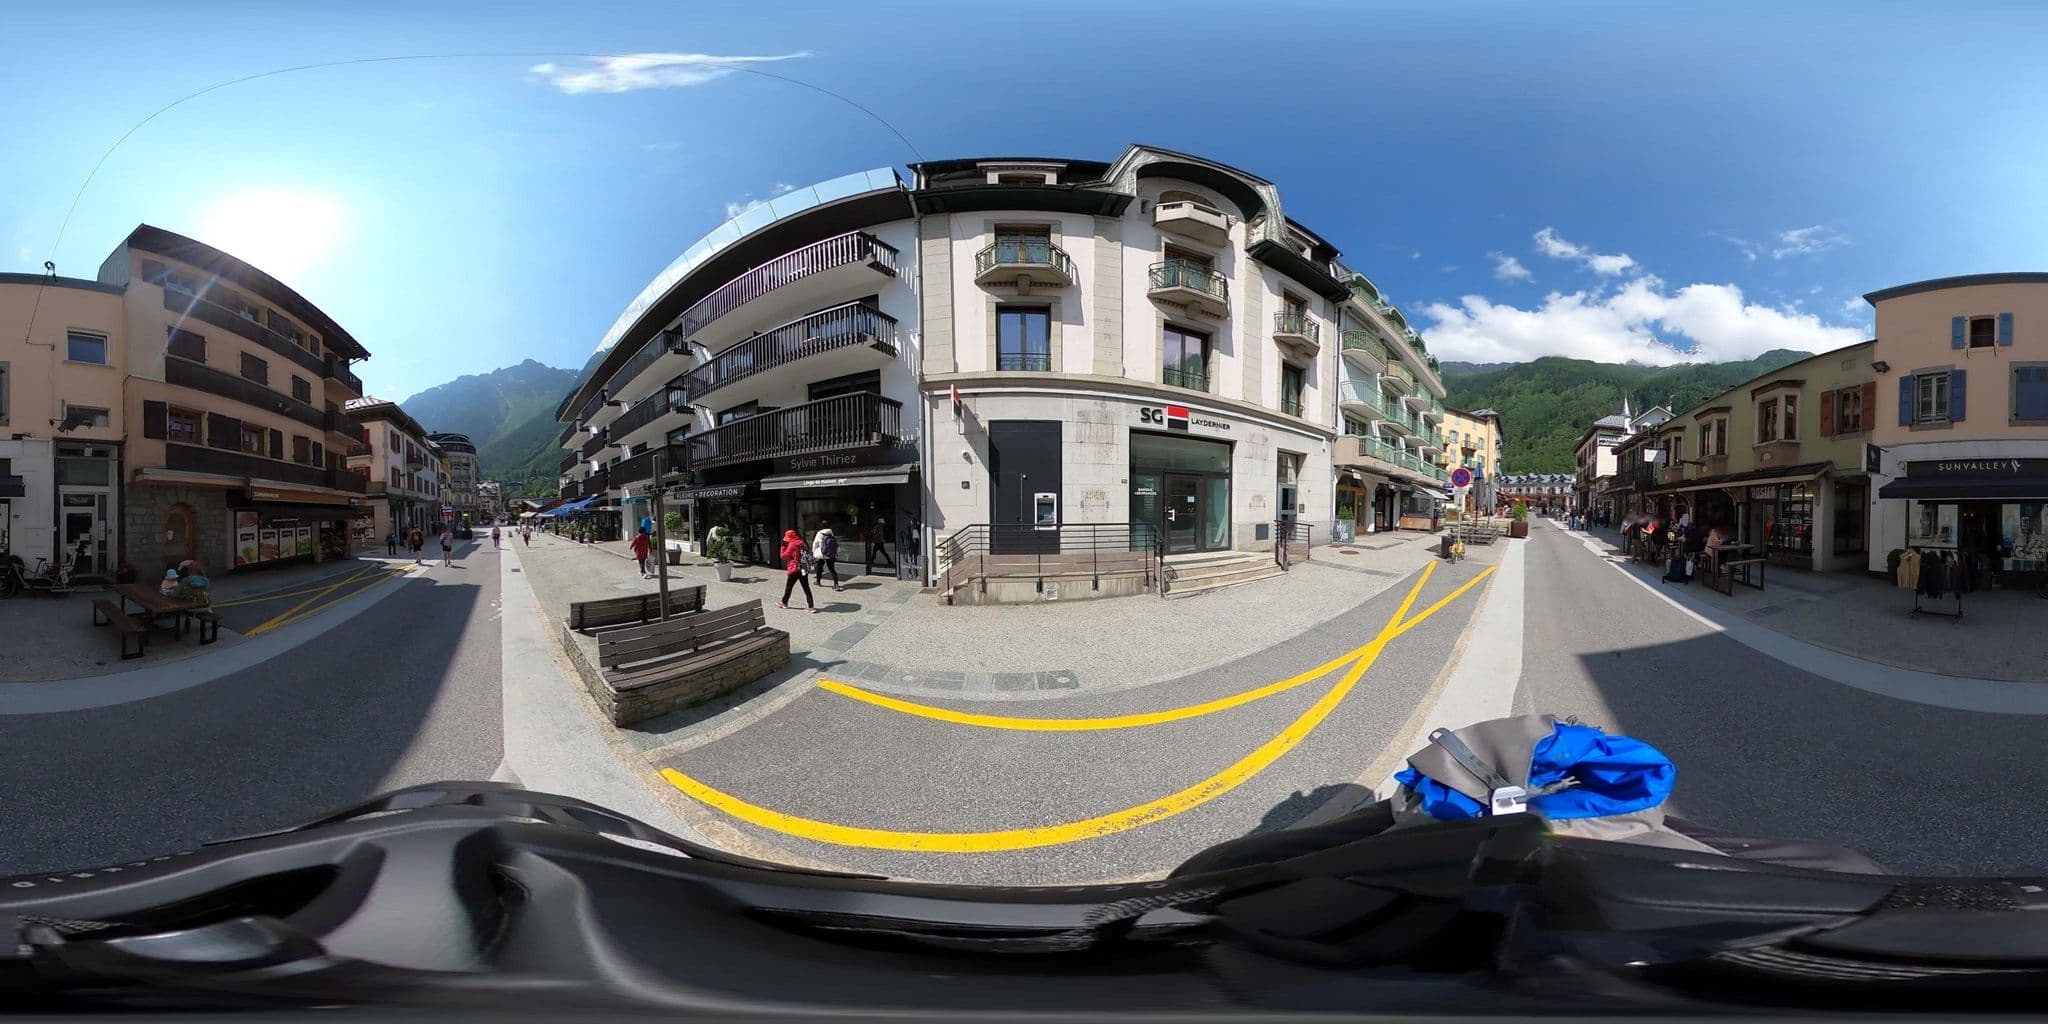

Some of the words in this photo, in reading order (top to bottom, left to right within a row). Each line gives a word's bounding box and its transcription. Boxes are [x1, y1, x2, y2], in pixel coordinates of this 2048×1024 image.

[1140, 407, 1164, 425] SG
[791, 458, 817, 470] Sylvie
[820, 454, 857, 466] Thiriez
[1937, 462, 2008, 472] SUNVALLEY
